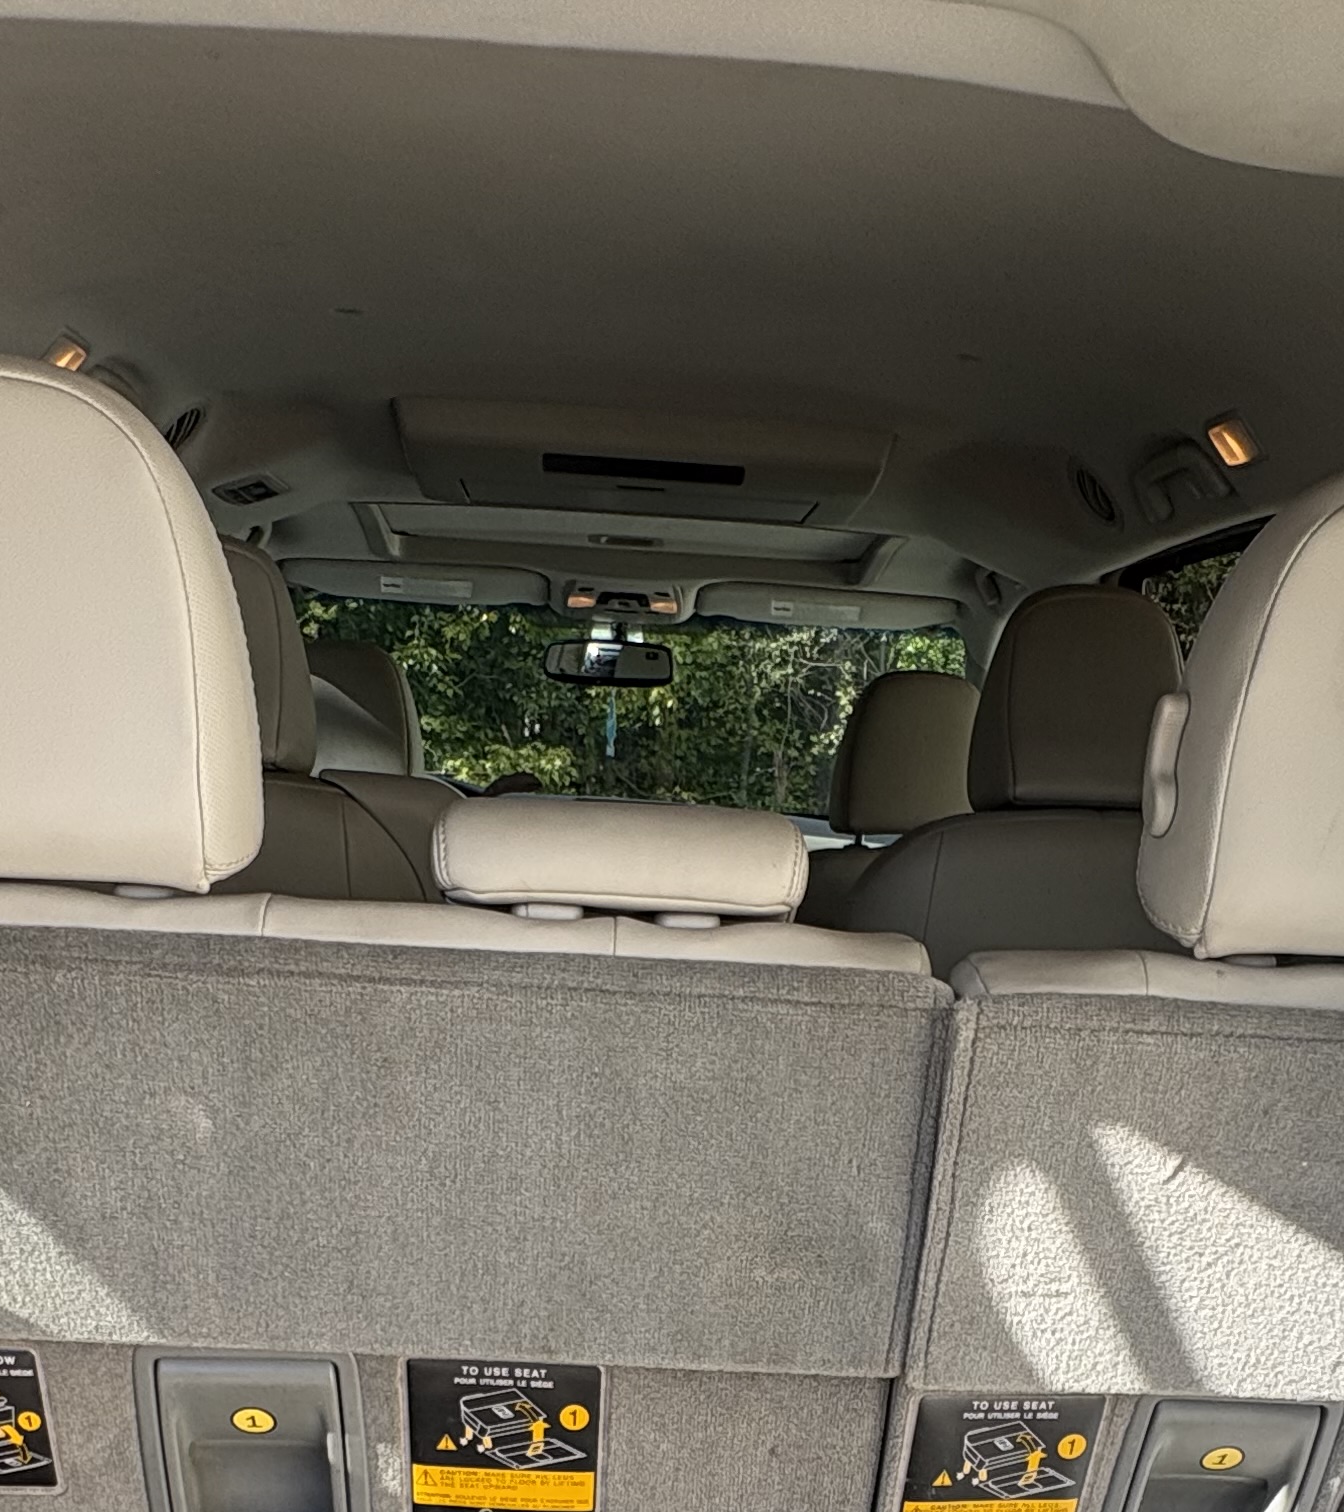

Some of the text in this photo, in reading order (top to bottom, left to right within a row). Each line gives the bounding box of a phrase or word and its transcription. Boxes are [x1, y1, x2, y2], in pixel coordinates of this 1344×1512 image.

[461, 1365, 548, 1379] TO USE SEAT
[453, 1377, 477, 1385] POUR
[479, 1378, 515, 1387] UTILISER
[517, 1379, 528, 1388] LE
[972, 1401, 1056, 1410] TO USE SEAT
[962, 1412, 985, 1420] POUR
[987, 1412, 1021, 1420] UTILISER
